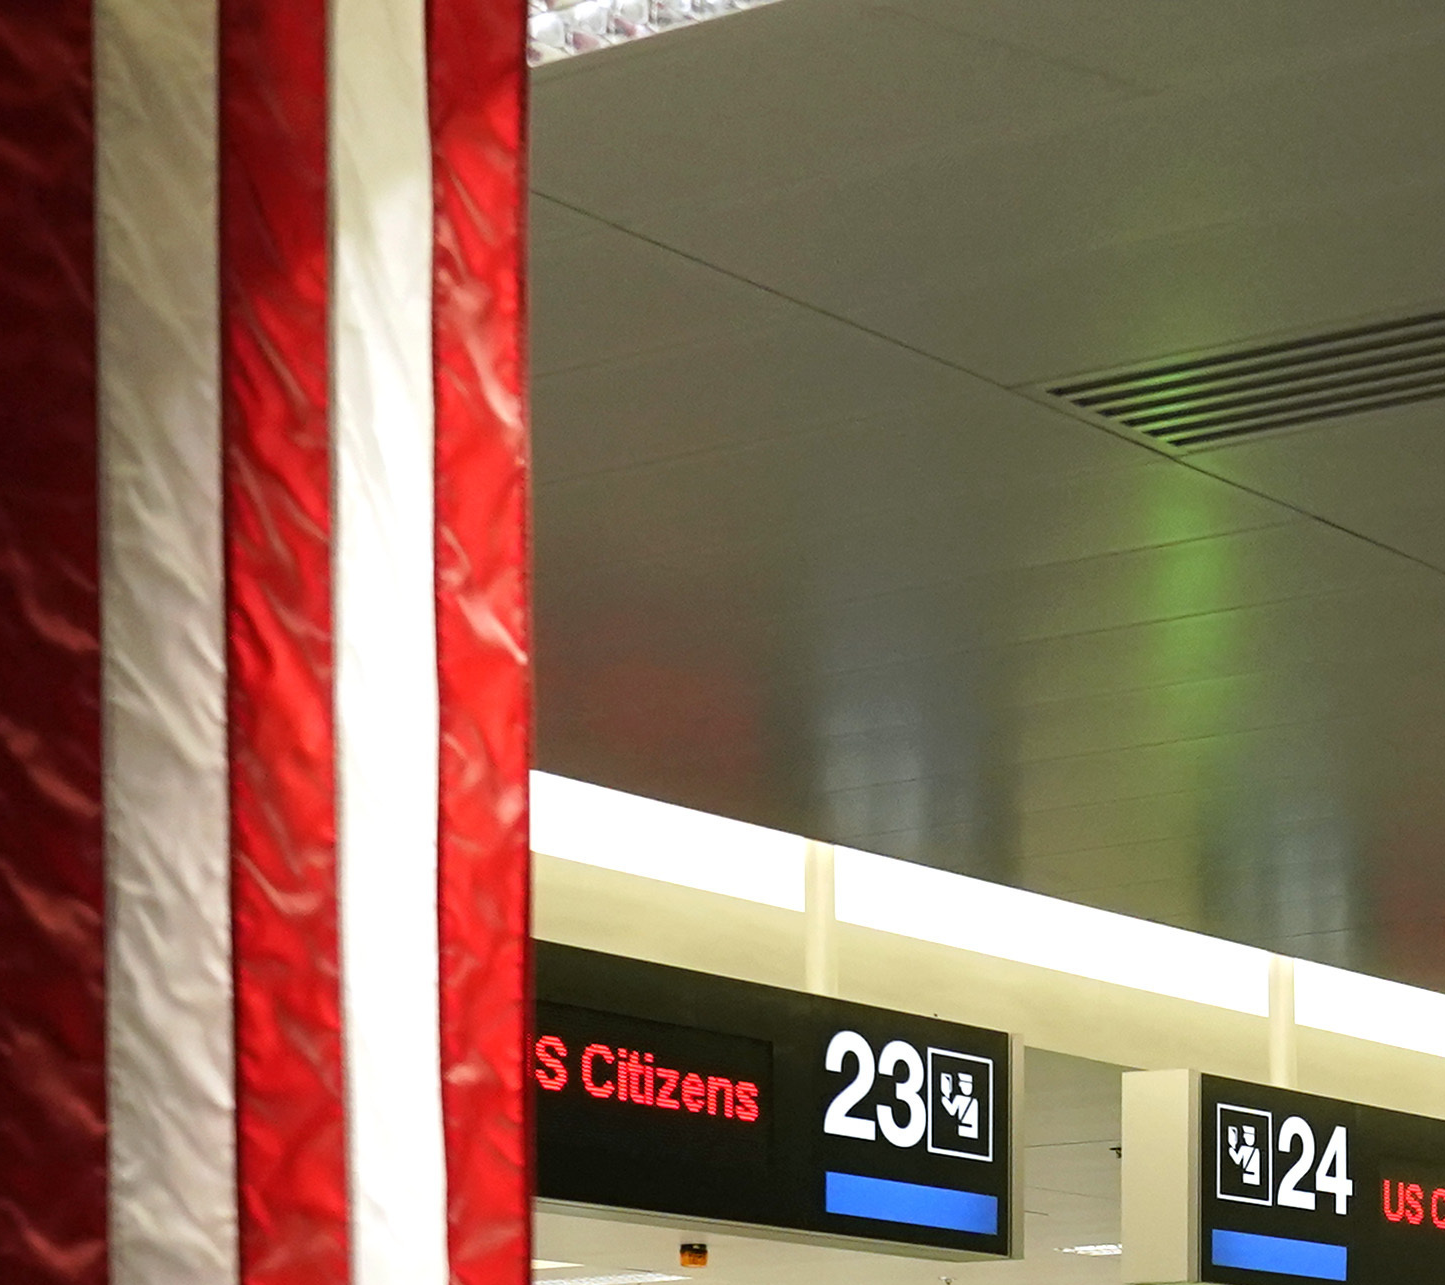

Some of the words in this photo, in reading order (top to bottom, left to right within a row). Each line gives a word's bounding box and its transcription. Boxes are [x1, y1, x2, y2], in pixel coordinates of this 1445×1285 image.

[527, 1034, 568, 1092] S
[580, 1043, 760, 1123] Citizens
[823, 1030, 928, 1149] 23
[1277, 1115, 1353, 1215] 24
[1382, 1179, 1424, 1225] US
